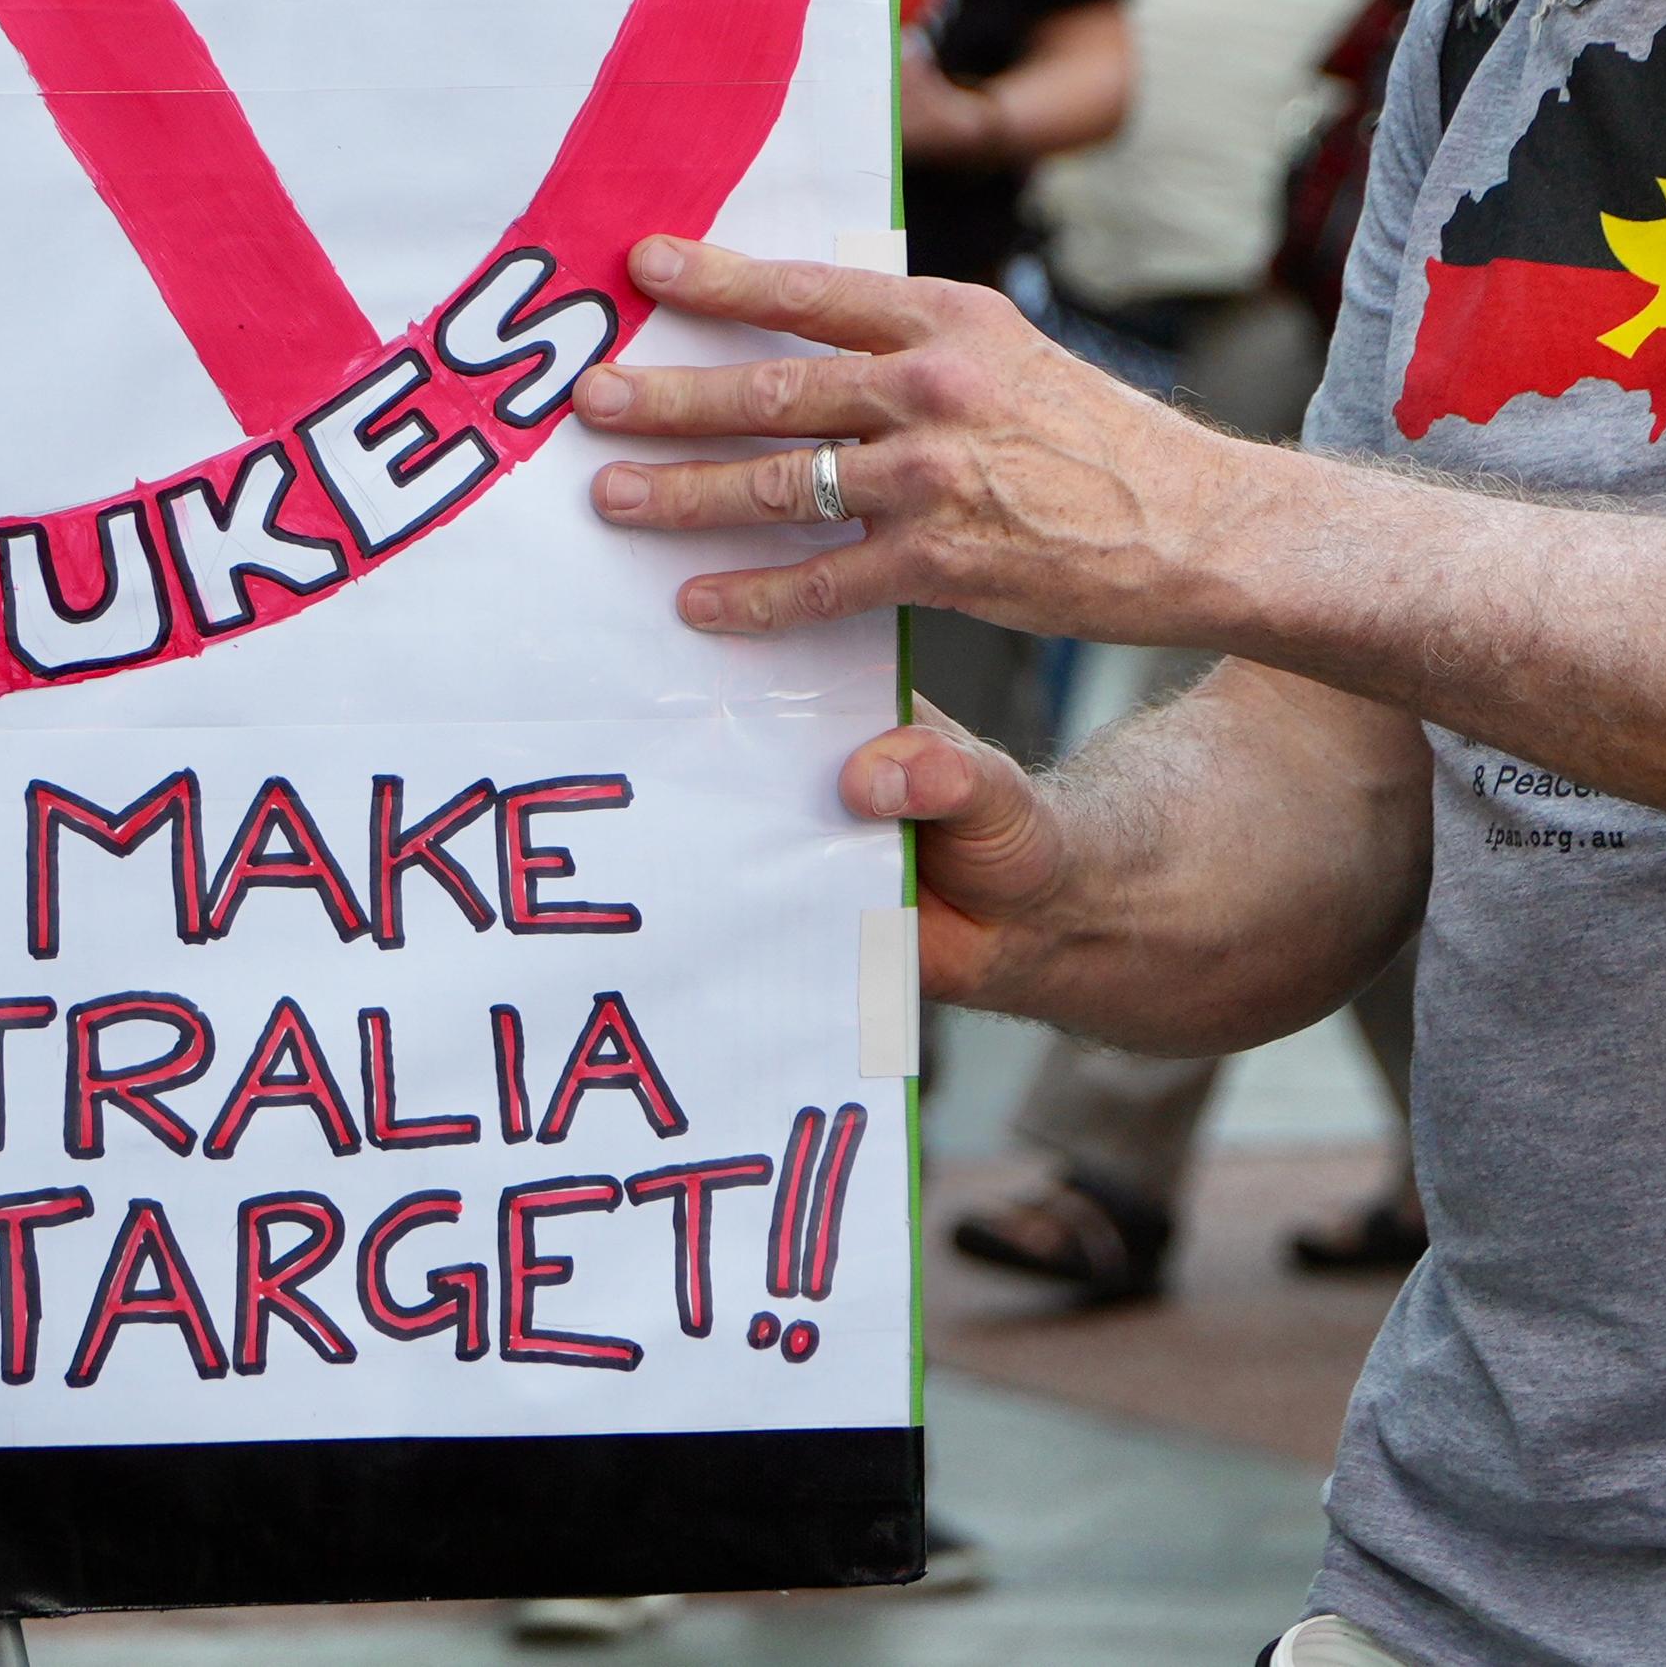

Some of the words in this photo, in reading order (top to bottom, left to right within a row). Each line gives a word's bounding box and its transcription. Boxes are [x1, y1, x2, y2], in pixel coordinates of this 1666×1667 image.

[1473, 765, 1486, 797] &
[1485, 822, 1626, 853] ipan.org.au
[25, 769, 642, 957] MAKE
